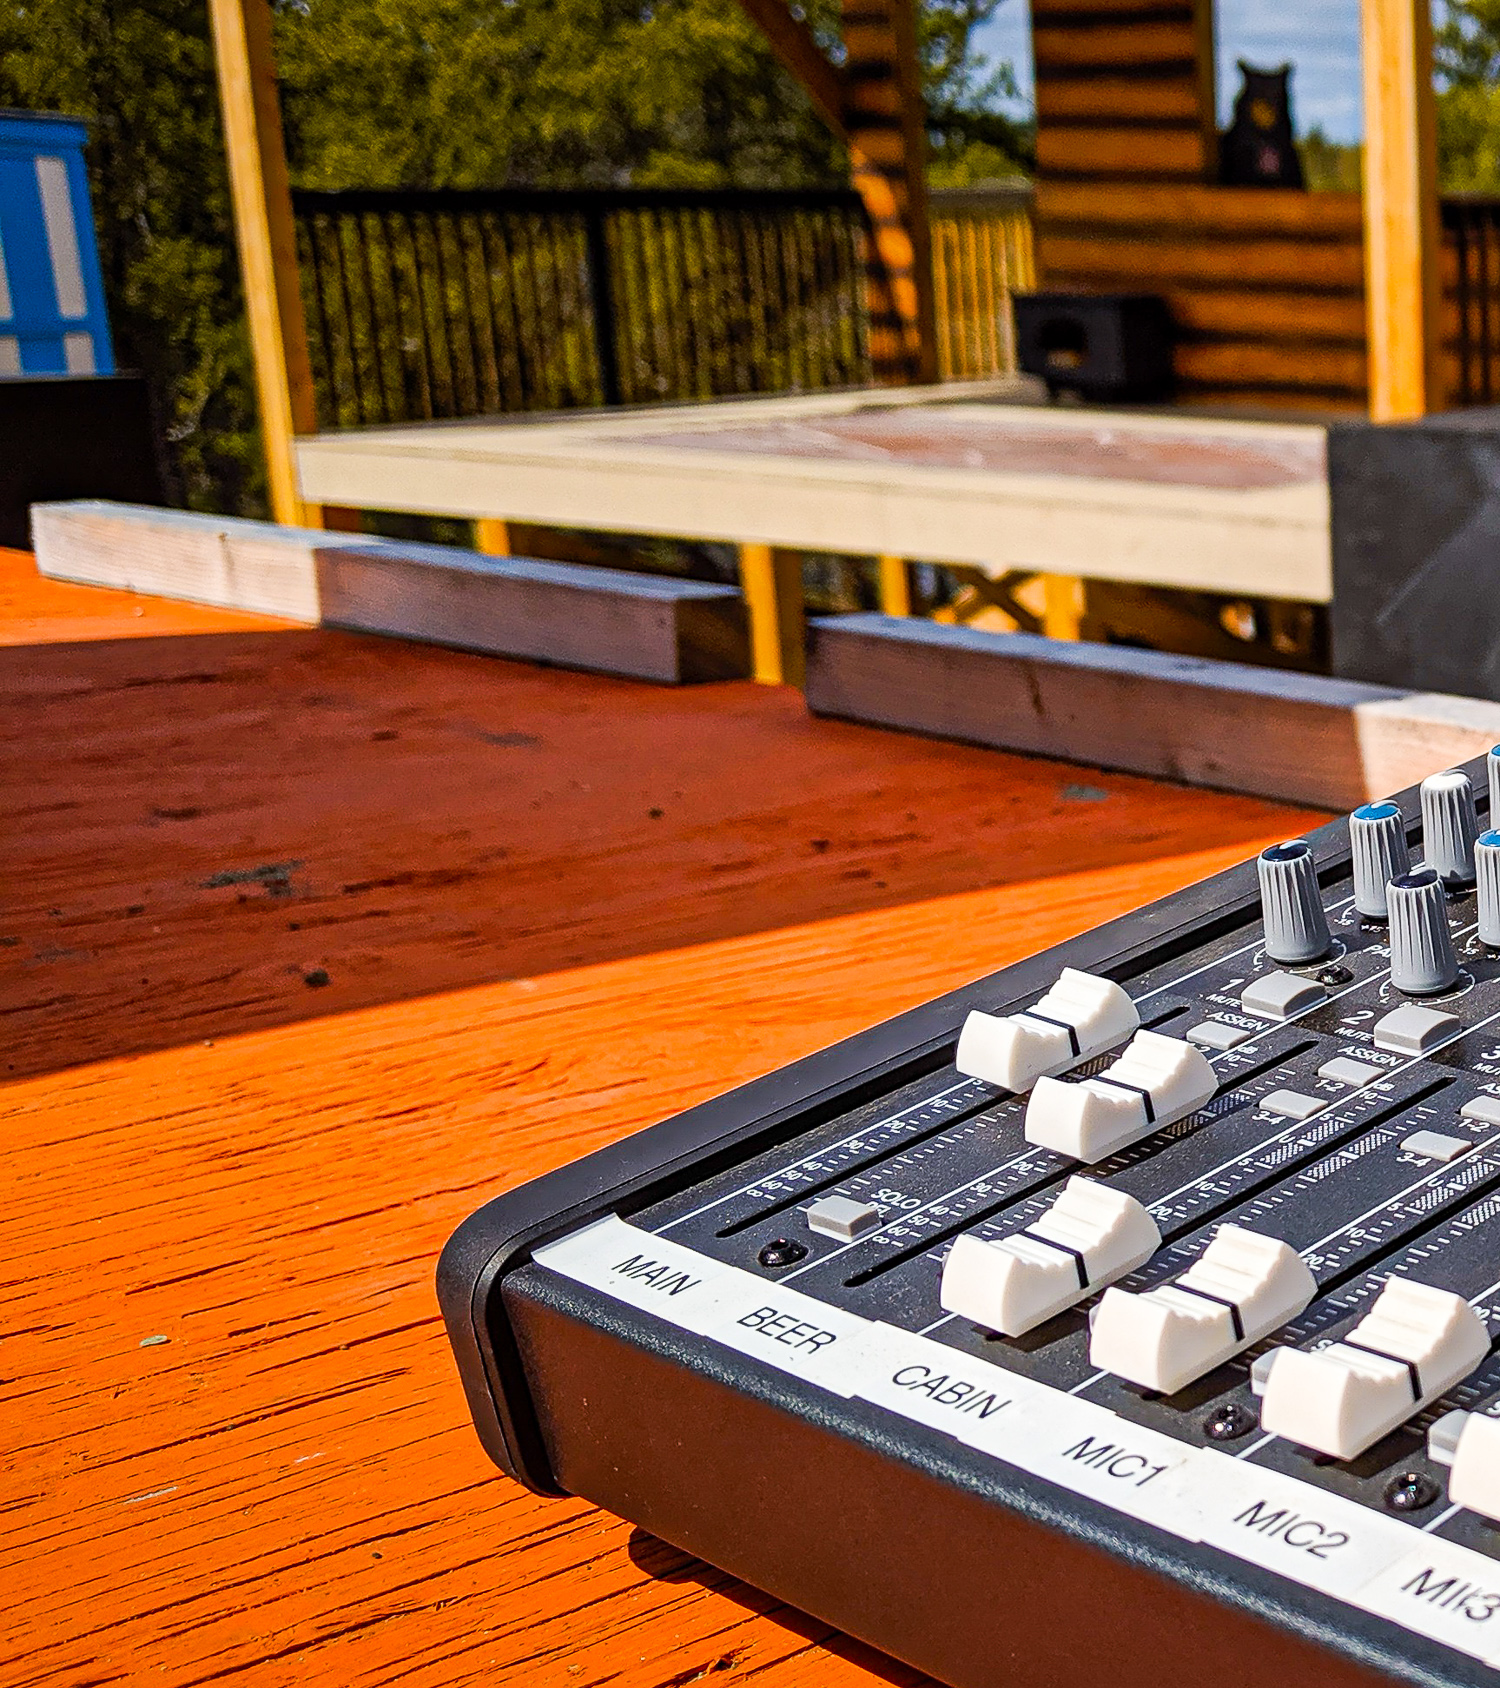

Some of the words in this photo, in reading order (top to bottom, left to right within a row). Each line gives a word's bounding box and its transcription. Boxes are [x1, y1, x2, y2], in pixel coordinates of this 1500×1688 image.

[1220, 978, 1245, 991] 1
[1206, 994, 1242, 1008] MUTE
[1206, 1011, 1270, 1032] ASSIGN
[1341, 1010, 1374, 1025] 2
[1335, 1027, 1374, 1042] MUTE
[1223, 1053, 1240, 1062] 10
[1337, 1045, 1404, 1067] ASSIGN
[1315, 1079, 1345, 1092] 1-2
[1358, 1091, 1377, 1101] 10
[931, 1098, 948, 1108] 10
[1252, 1111, 1287, 1125] 3-4
[1458, 1118, 1491, 1133] 1-2
[802, 1161, 822, 1171] 40
[1397, 1152, 1432, 1167] 3-4
[781, 1169, 803, 1181] 50
[761, 1179, 783, 1190] 60
[970, 1182, 993, 1194] 30
[1195, 1181, 1215, 1191] 10
[870, 1188, 922, 1210] SOLO
[927, 1205, 950, 1216] 40
[1150, 1205, 1172, 1216] 20
[907, 1214, 930, 1226] 50
[887, 1226, 909, 1237] 60
[1345, 1227, 1365, 1238] 10
[1302, 1253, 1325, 1266] 20
[611, 1254, 702, 1296] MAIN
[736, 1307, 838, 1356] BEER
[891, 1365, 1012, 1420] CABIN
[1061, 1436, 1169, 1487] MIC1
[1233, 1500, 1351, 1559] MIC2
